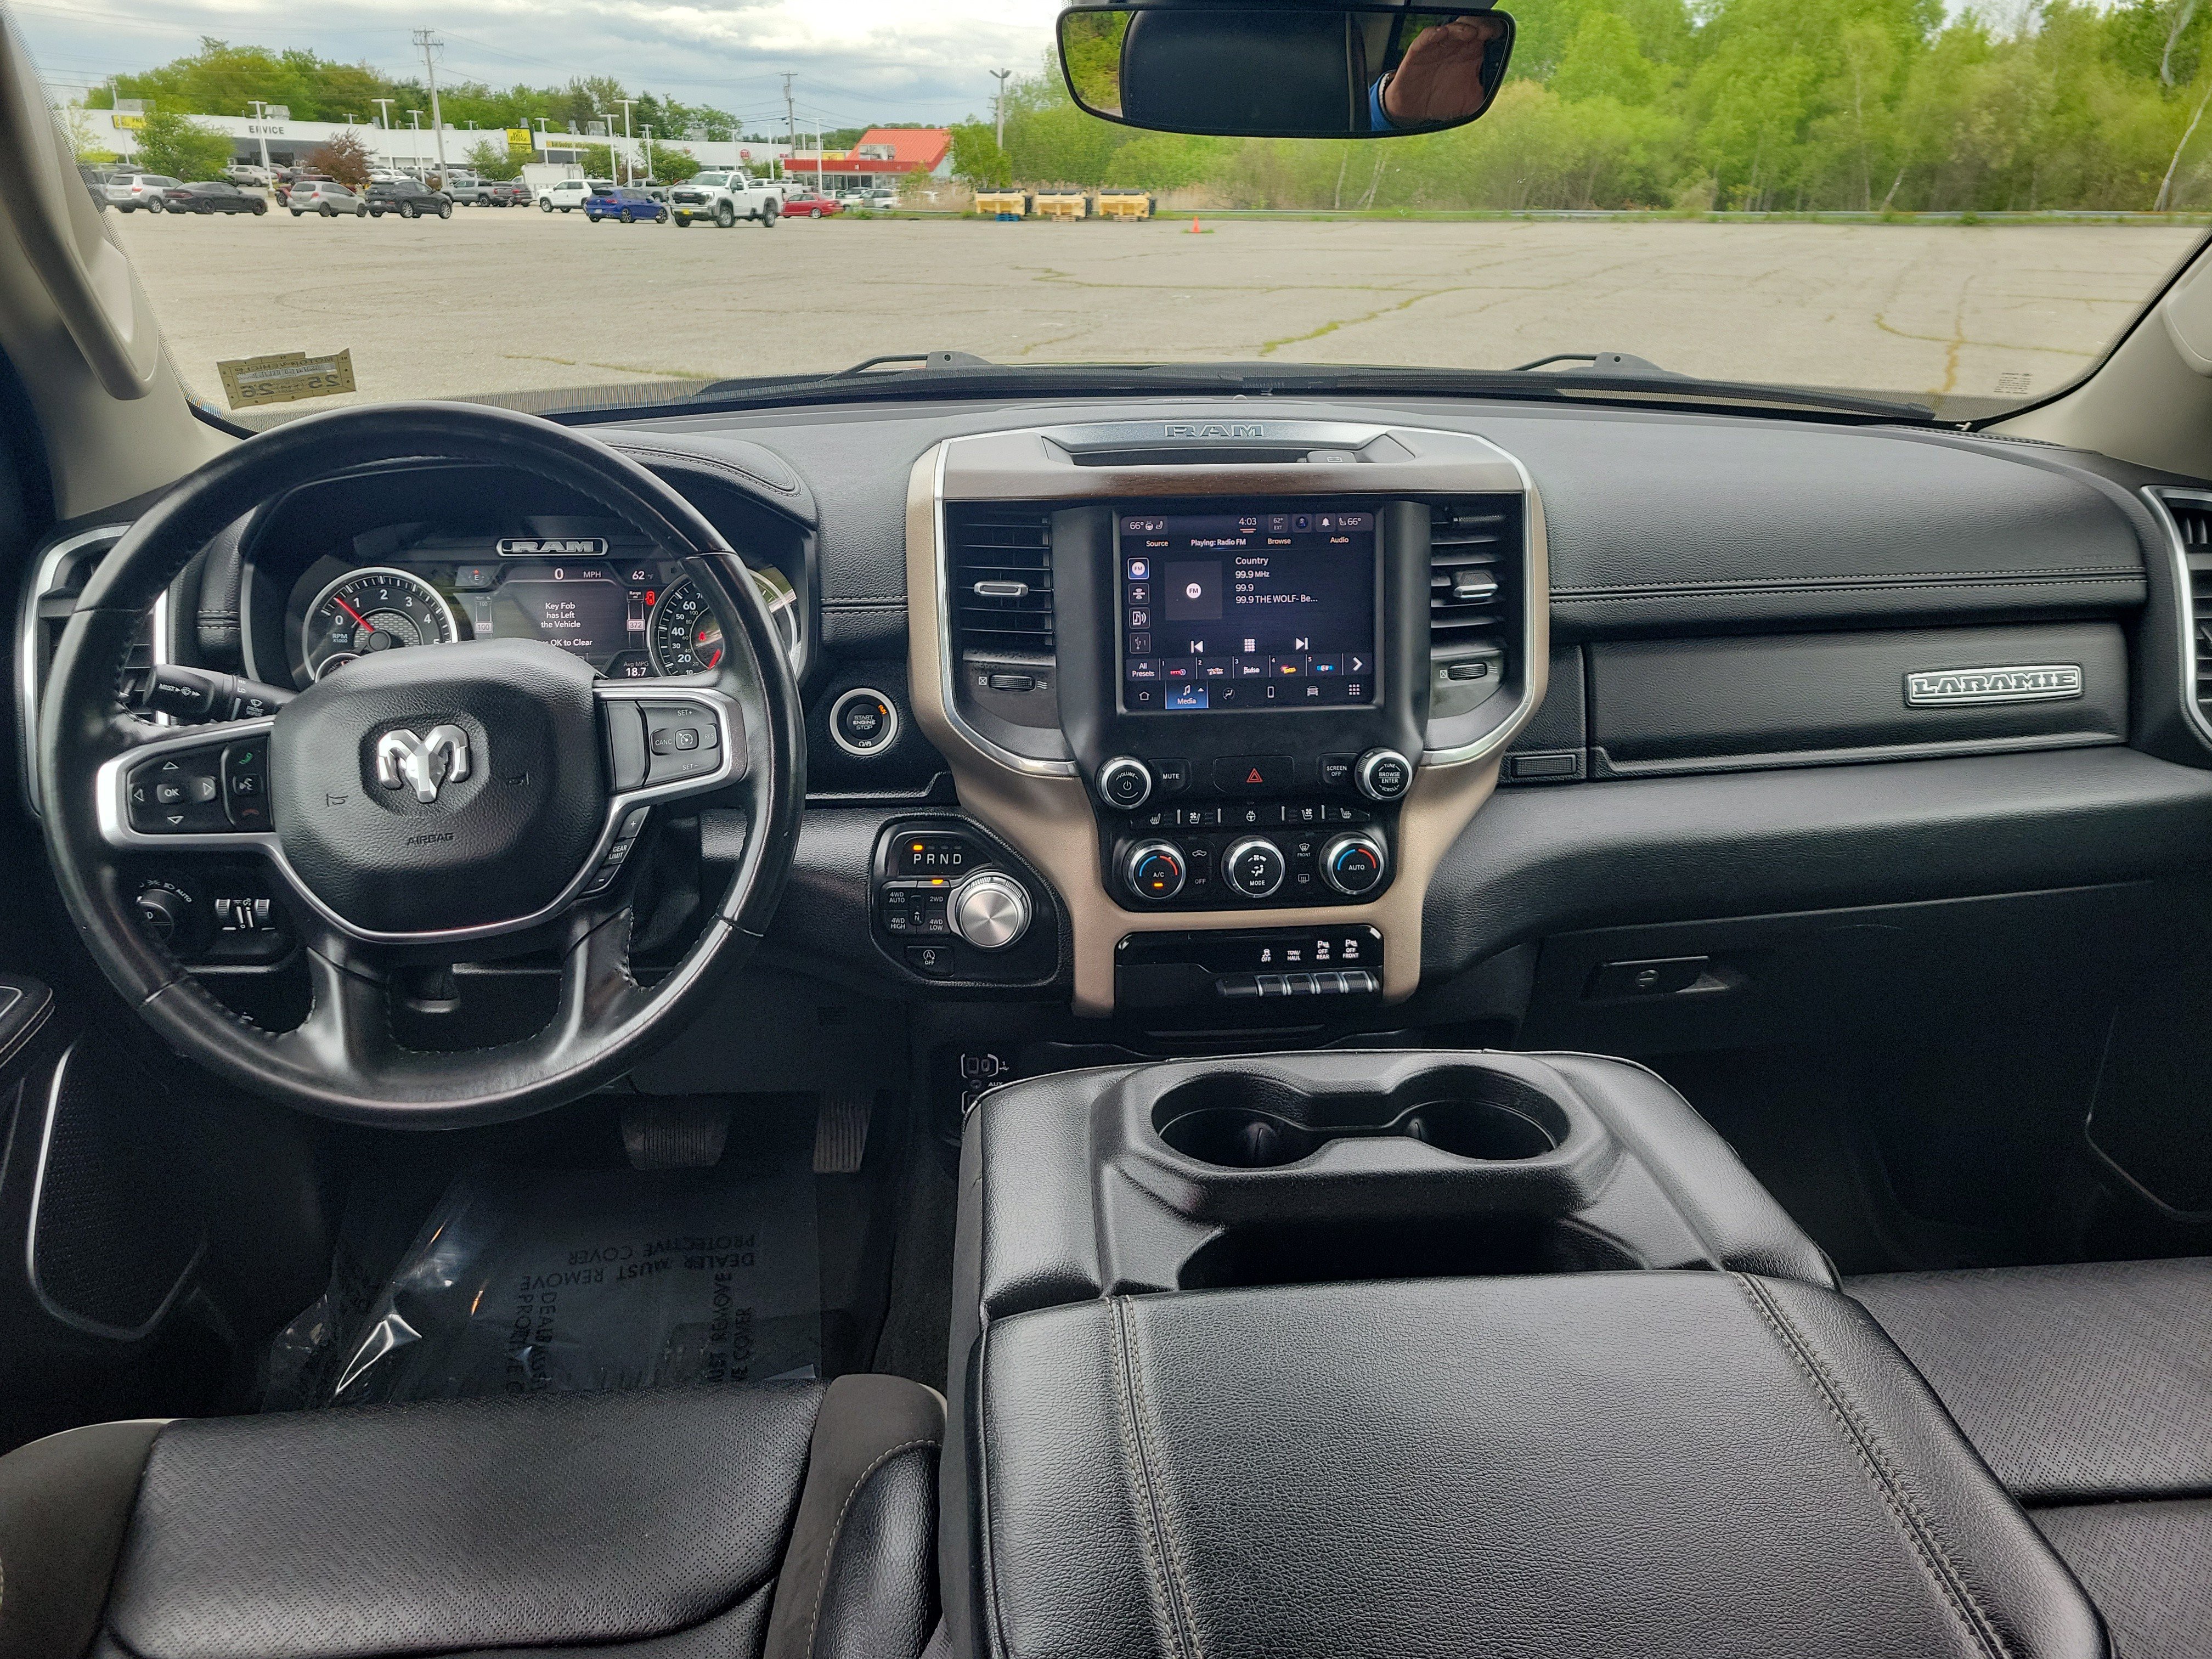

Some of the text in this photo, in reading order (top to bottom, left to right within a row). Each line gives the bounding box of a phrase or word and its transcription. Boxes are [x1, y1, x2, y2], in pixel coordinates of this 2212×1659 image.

[1164, 424, 1264, 437] RAM
[1238, 517, 1257, 526] 4:03
[512, 540, 594, 553] RAM
[1190, 539, 1216, 548] Playing:
[1235, 556, 1269, 566] Country
[554, 568, 564, 580] 0
[583, 571, 602, 579] MPH
[632, 571, 645, 580] 62
[1235, 571, 1254, 579] 99.9
[1235, 583, 1254, 592] 99.9
[380, 589, 388, 600] 2
[353, 597, 360, 608] 1
[405, 596, 413, 607] 3
[1235, 596, 1254, 604] 99.9
[1255, 596, 1272, 604] THE
[545, 602, 575, 612] Key Fob
[682, 601, 696, 610] 60
[335, 615, 343, 625] 0
[424, 613, 432, 624] 4
[546, 611, 575, 619] has Left
[540, 620, 554, 628] the
[671, 627, 685, 636] 40
[678, 654, 691, 663] 20
[625, 667, 647, 677] 18.7
[1914, 670, 2077, 695] LARAMIE
[165, 788, 180, 798] OK
[407, 832, 456, 847] AIRBAG
[613, 844, 627, 853] GEAR
[568, 1245, 633, 1265] COVER
[519, 1268, 603, 1291] REMOVE
